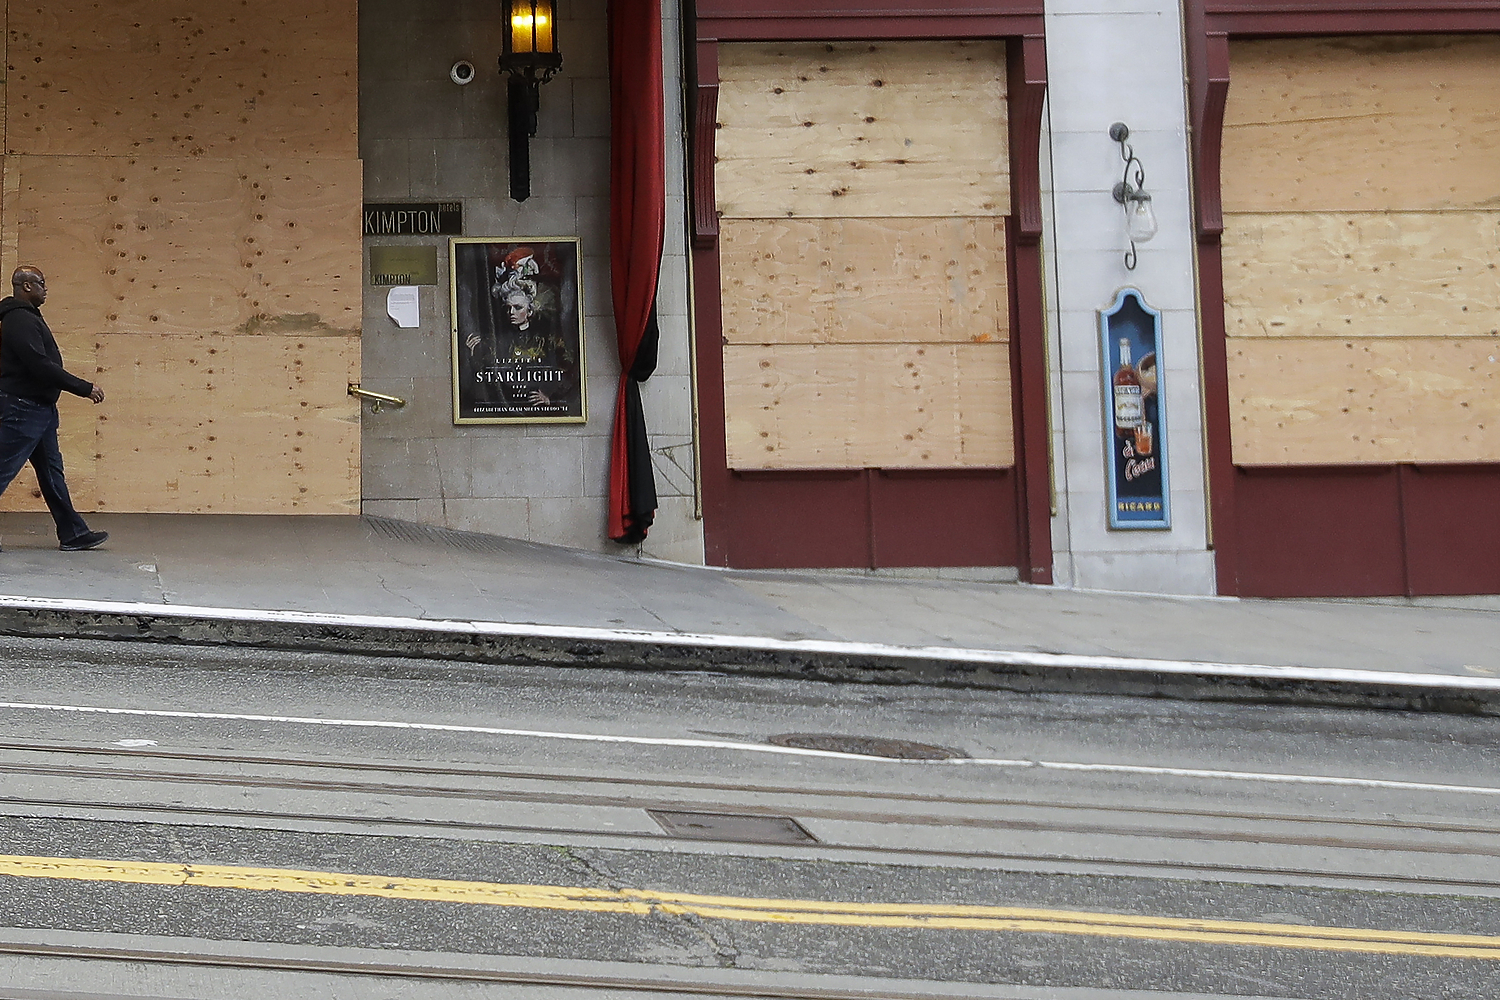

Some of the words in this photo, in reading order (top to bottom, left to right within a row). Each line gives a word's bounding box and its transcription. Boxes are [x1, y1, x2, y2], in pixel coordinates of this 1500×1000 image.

[365, 210, 440, 234] KIMPTON
[373, 273, 411, 285] KIMPTON
[476, 370, 564, 383] STARLIGHT
